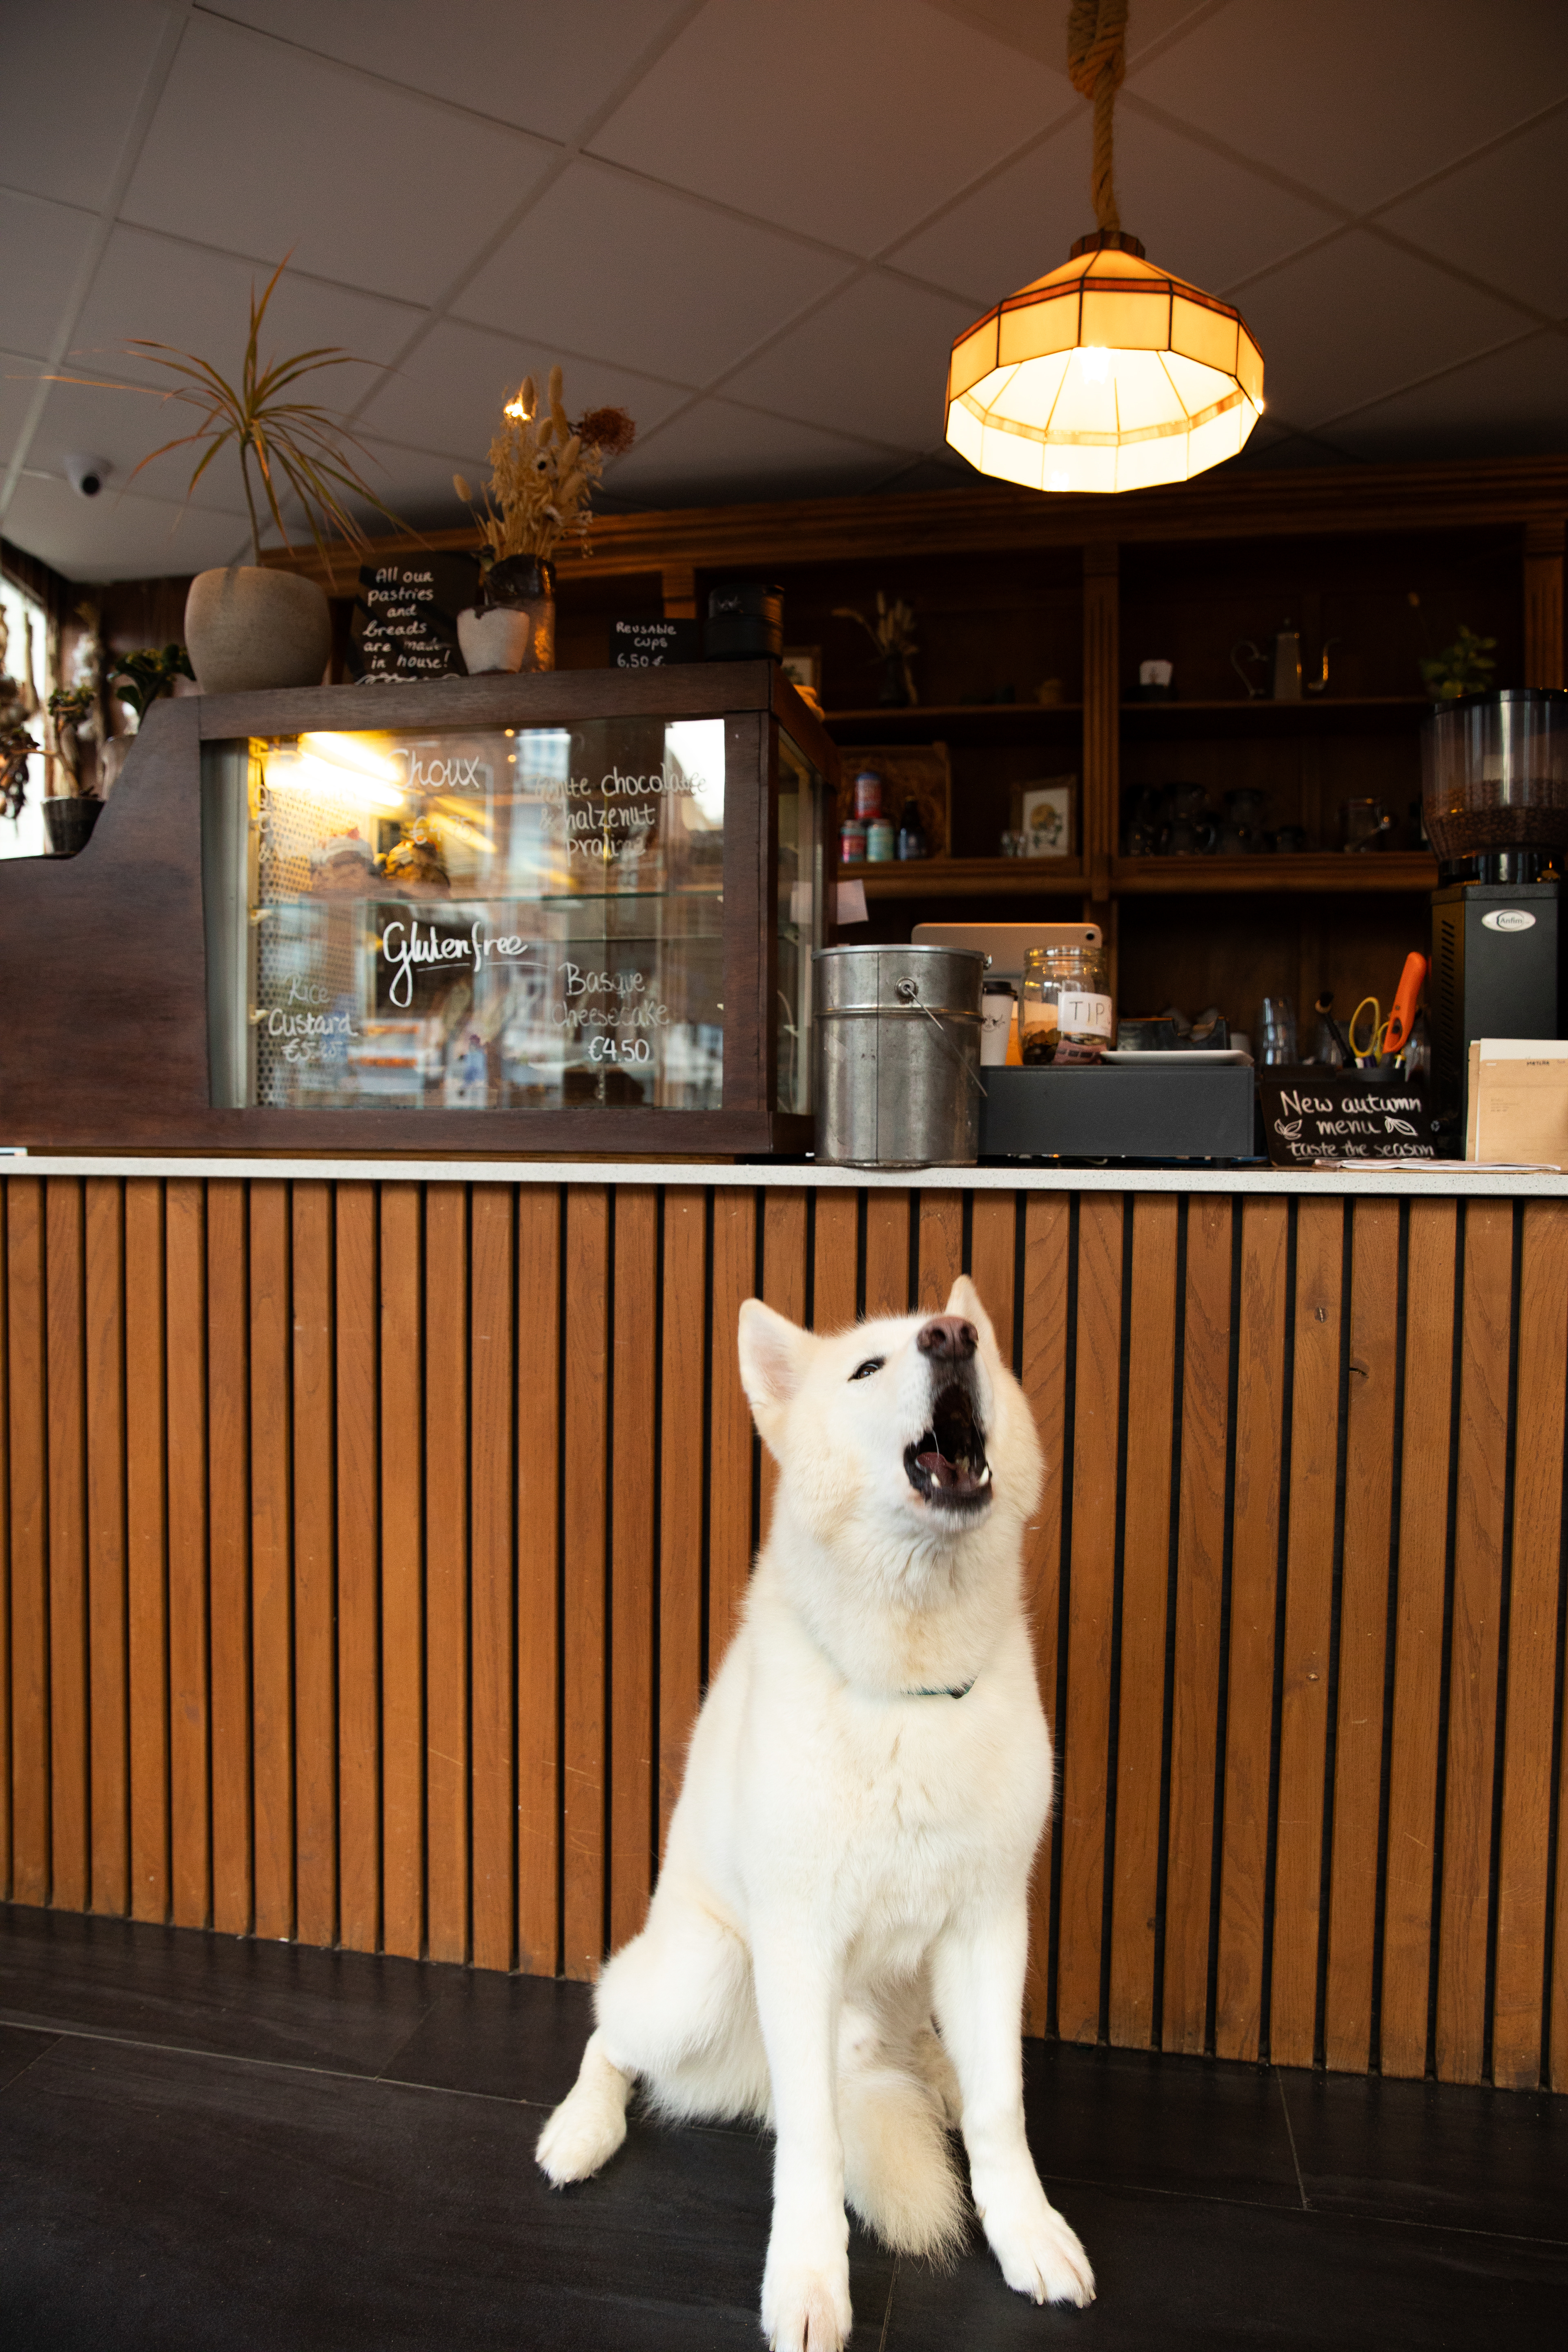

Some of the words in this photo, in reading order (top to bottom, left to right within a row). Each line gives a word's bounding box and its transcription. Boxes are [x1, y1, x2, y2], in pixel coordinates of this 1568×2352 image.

[376, 566, 398, 583] All
[403, 571, 434, 583] our
[368, 586, 434, 607] pastries
[387, 604, 417, 618] and
[362, 619, 427, 637] breads
[363, 641, 391, 652] are
[371, 655, 386, 669] in
[396, 649, 450, 668] house!
[385, 748, 480, 791] Choux
[558, 961, 645, 998] Basque
[268, 1008, 359, 1036] Custard
[588, 1036, 650, 1062] €4.50
[1280, 1090, 1333, 1116] New
[1341, 1094, 1422, 1114] autumn
[1316, 1119, 1382, 1136] menu
[1286, 1141, 1339, 1157] taste
[1340, 1140, 1370, 1157] the
[1374, 1143, 1434, 1157] season
